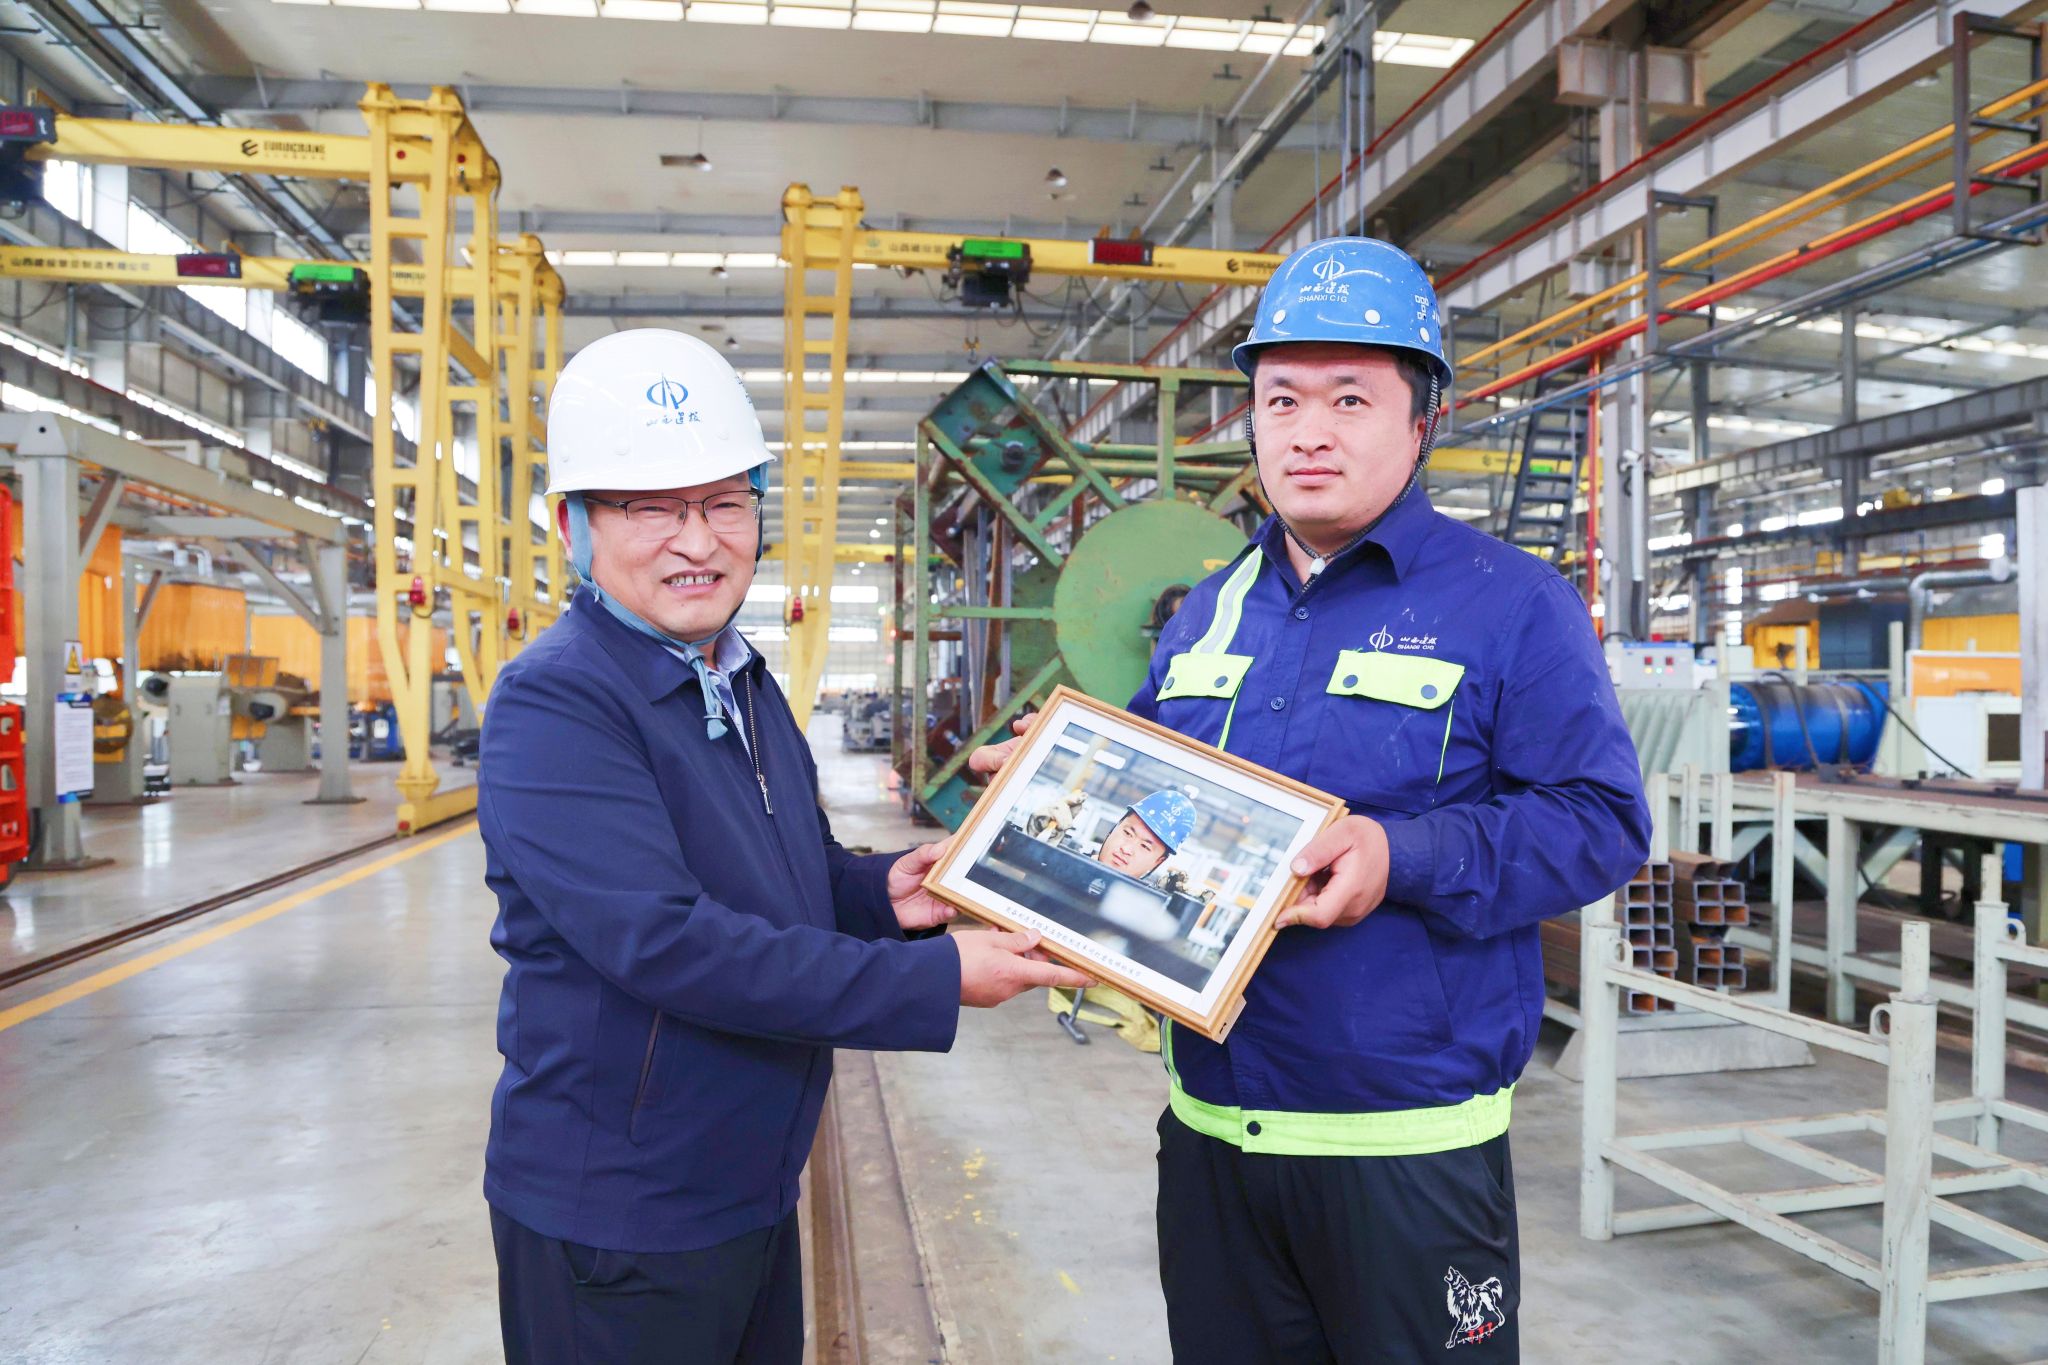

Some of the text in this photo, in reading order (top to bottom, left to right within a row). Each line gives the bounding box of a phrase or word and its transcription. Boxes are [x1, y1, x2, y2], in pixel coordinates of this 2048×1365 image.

[1299, 281, 1350, 296] 山西建投
[1298, 294, 1348, 303] SHANXI CIG
